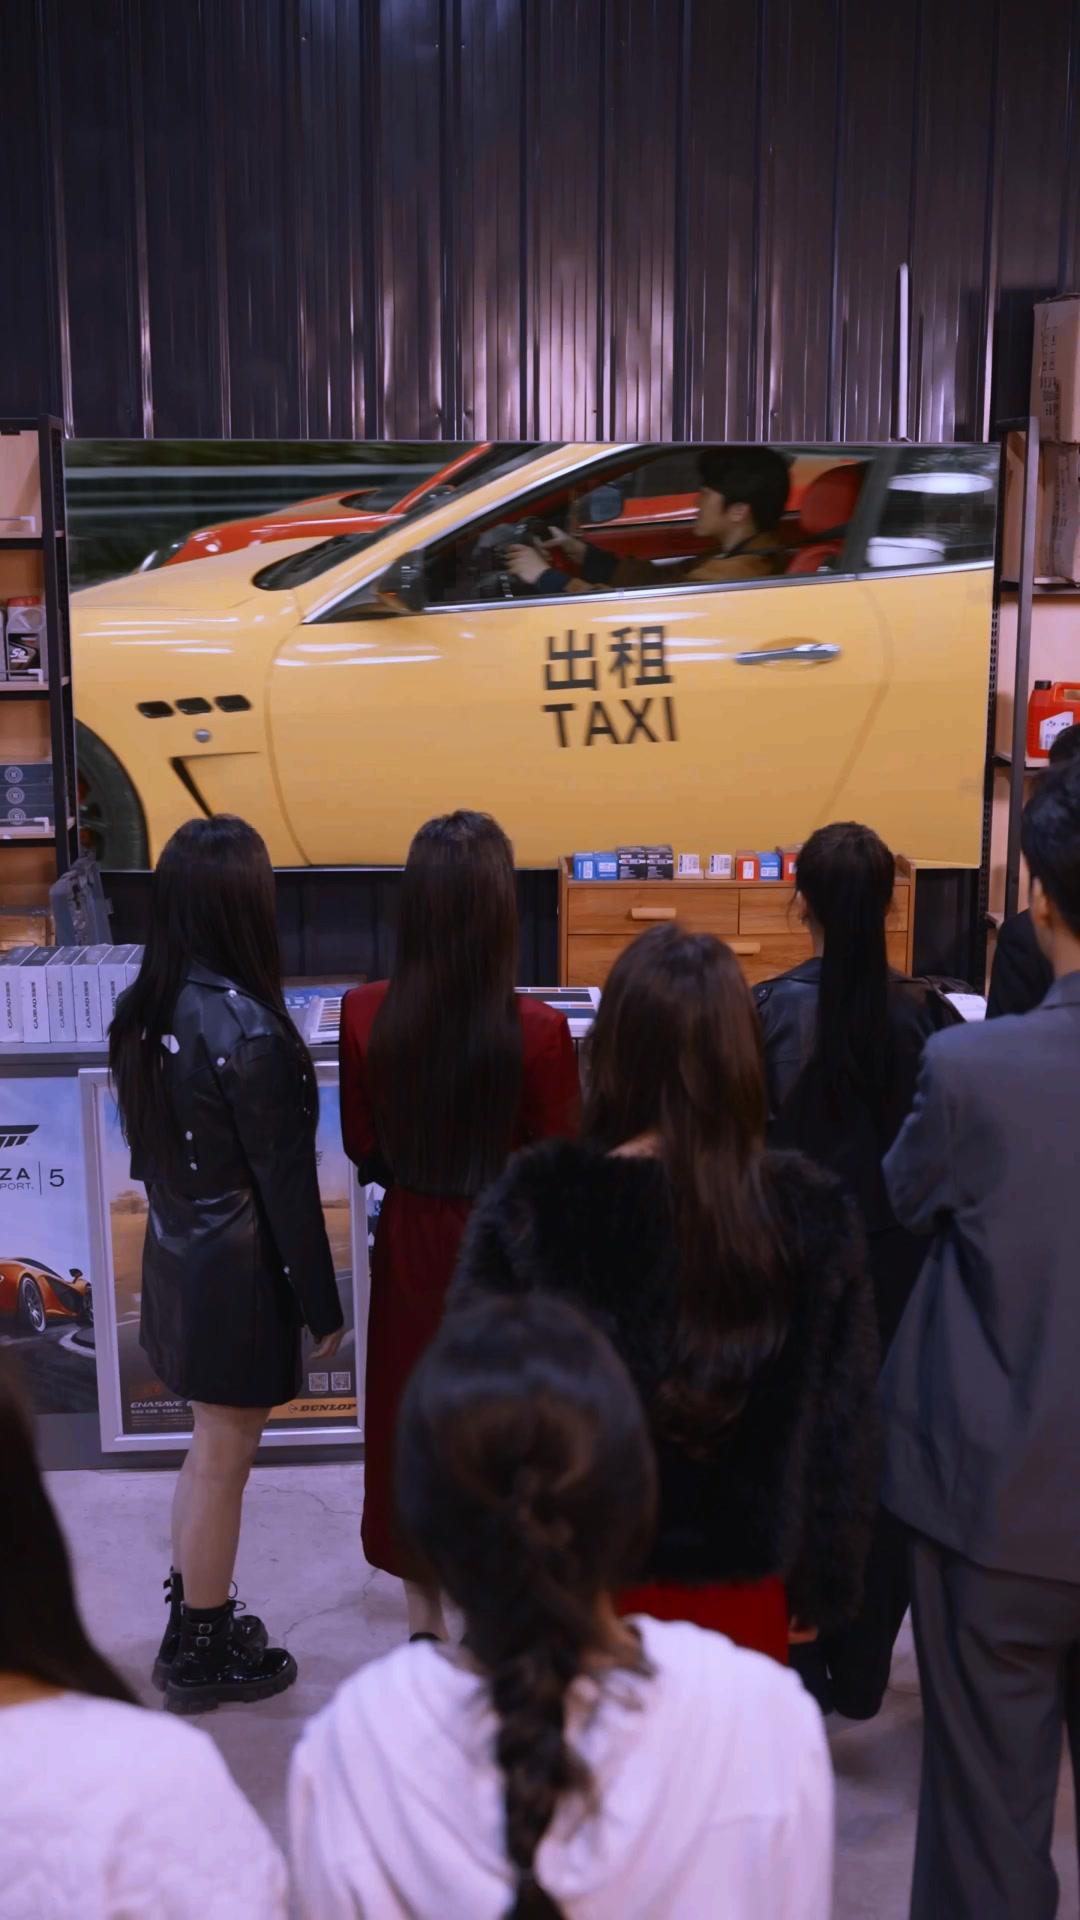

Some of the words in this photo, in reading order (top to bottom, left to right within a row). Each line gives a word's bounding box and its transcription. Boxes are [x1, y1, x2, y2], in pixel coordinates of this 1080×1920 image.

[544, 625, 673, 691] 出租
[542, 697, 677, 748] TAXI
[49, 1168, 65, 1187] 5
[300, 1403, 357, 1412] DUNLOP
